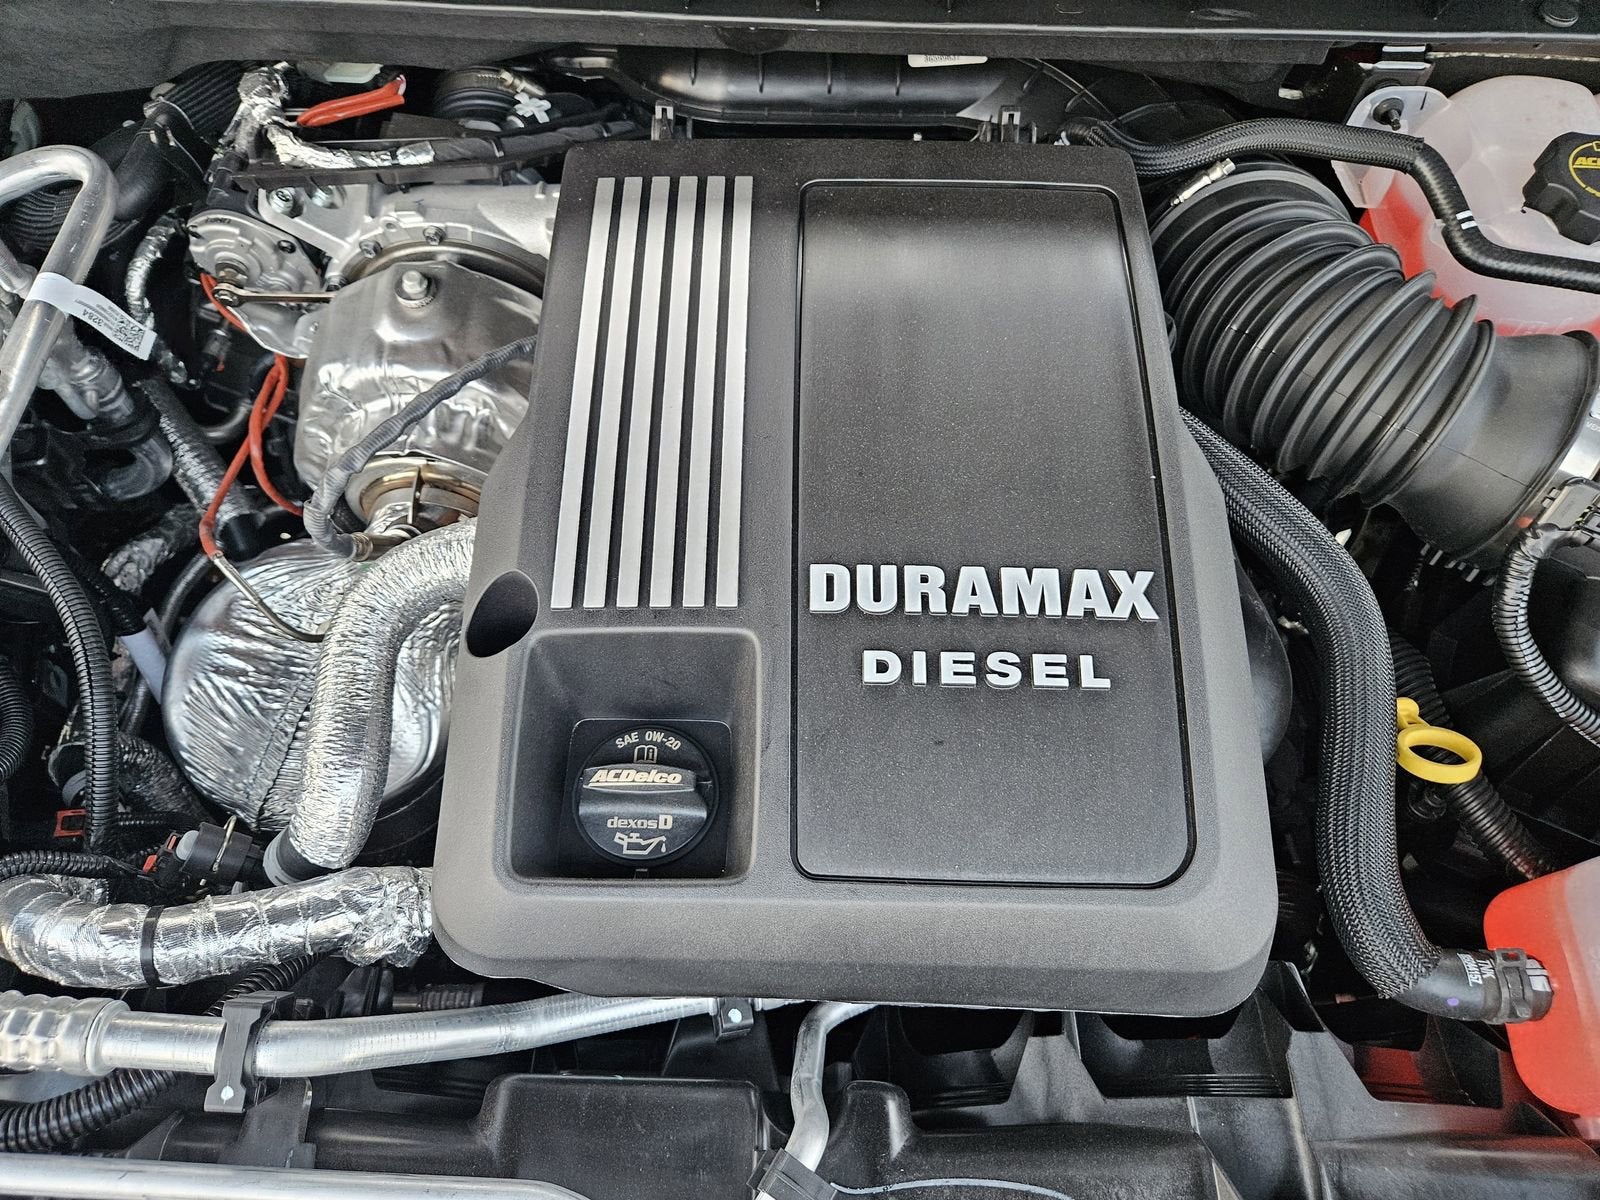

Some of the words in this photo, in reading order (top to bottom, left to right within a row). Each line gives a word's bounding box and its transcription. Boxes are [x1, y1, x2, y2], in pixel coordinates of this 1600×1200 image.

[809, 563, 1160, 621] DURAMAX
[862, 650, 1111, 690] DIESEL
[615, 732, 639, 748] SAE
[645, 730, 682, 751] 0W-20
[588, 769, 683, 785] ACDelco
